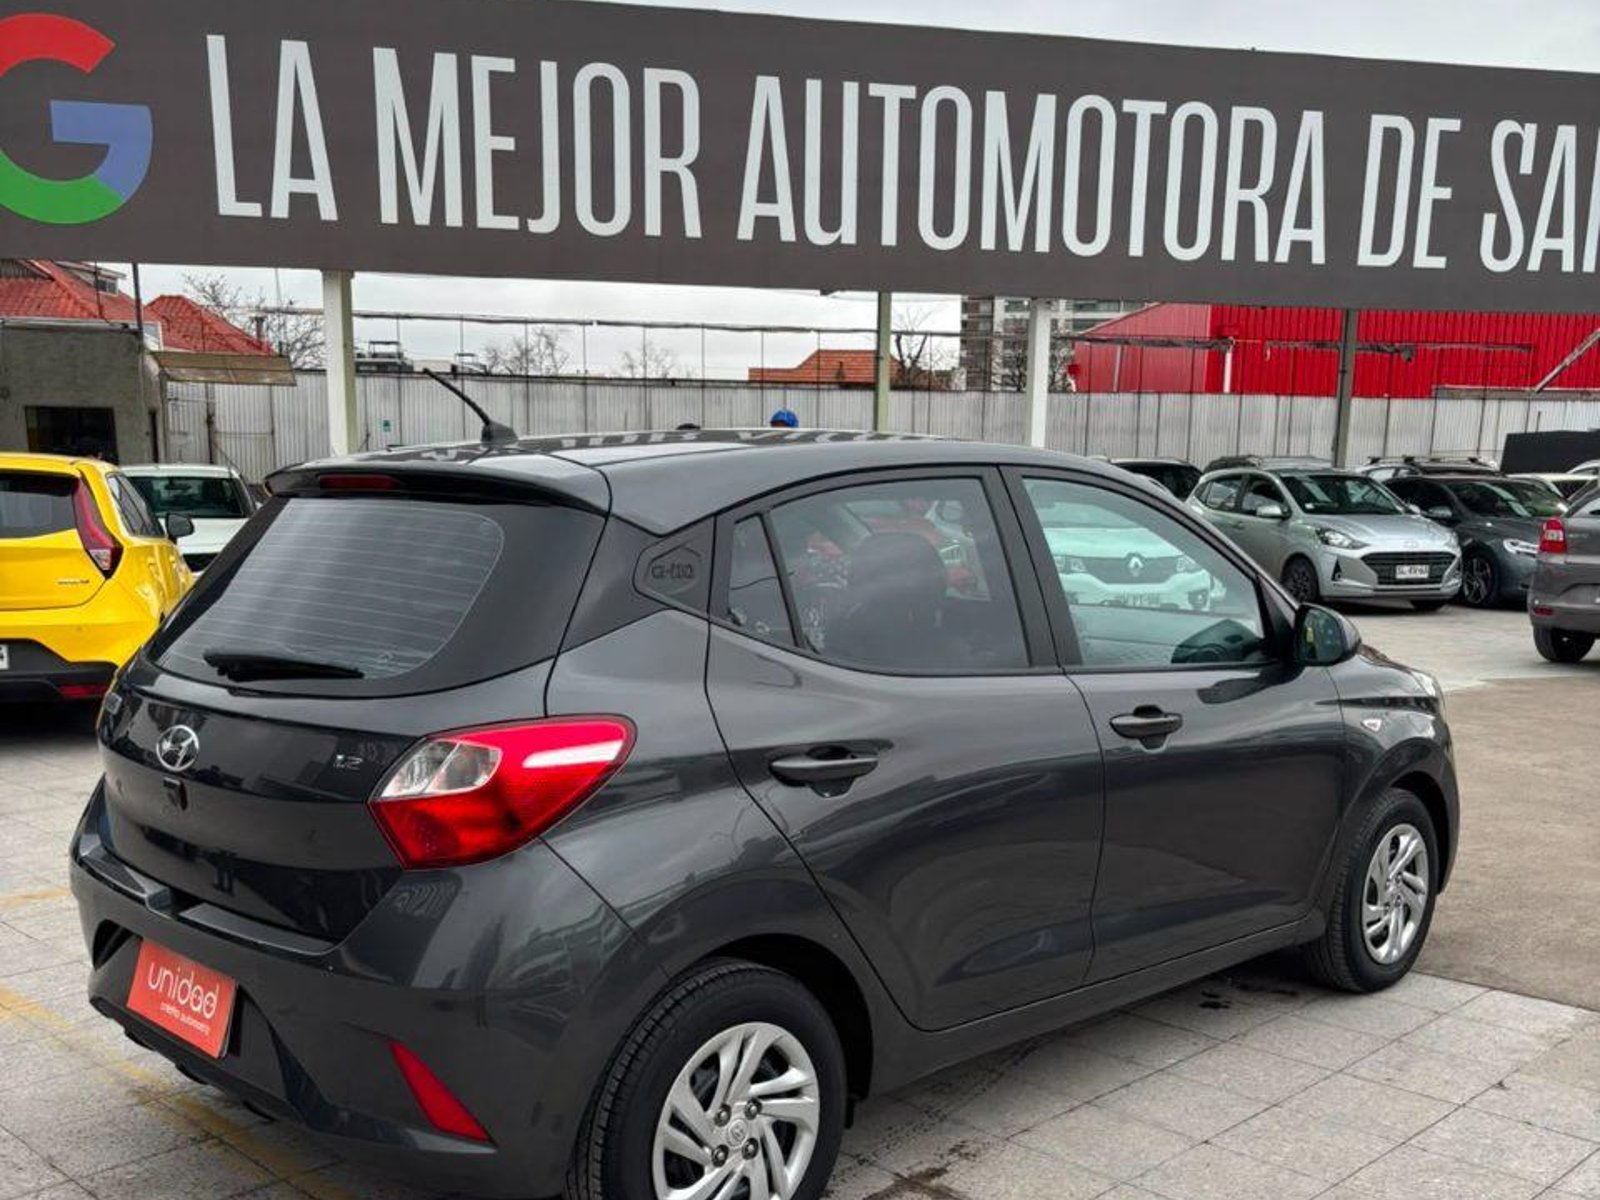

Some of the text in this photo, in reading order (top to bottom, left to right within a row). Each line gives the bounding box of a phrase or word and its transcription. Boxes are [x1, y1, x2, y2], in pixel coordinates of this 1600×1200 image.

[206, 34, 338, 221] LA
[372, 46, 702, 239] MEJOR
[737, 75, 1326, 265] AUTOMOTORA
[1357, 114, 1461, 269] DE
[147, 962, 220, 1019] unidad
